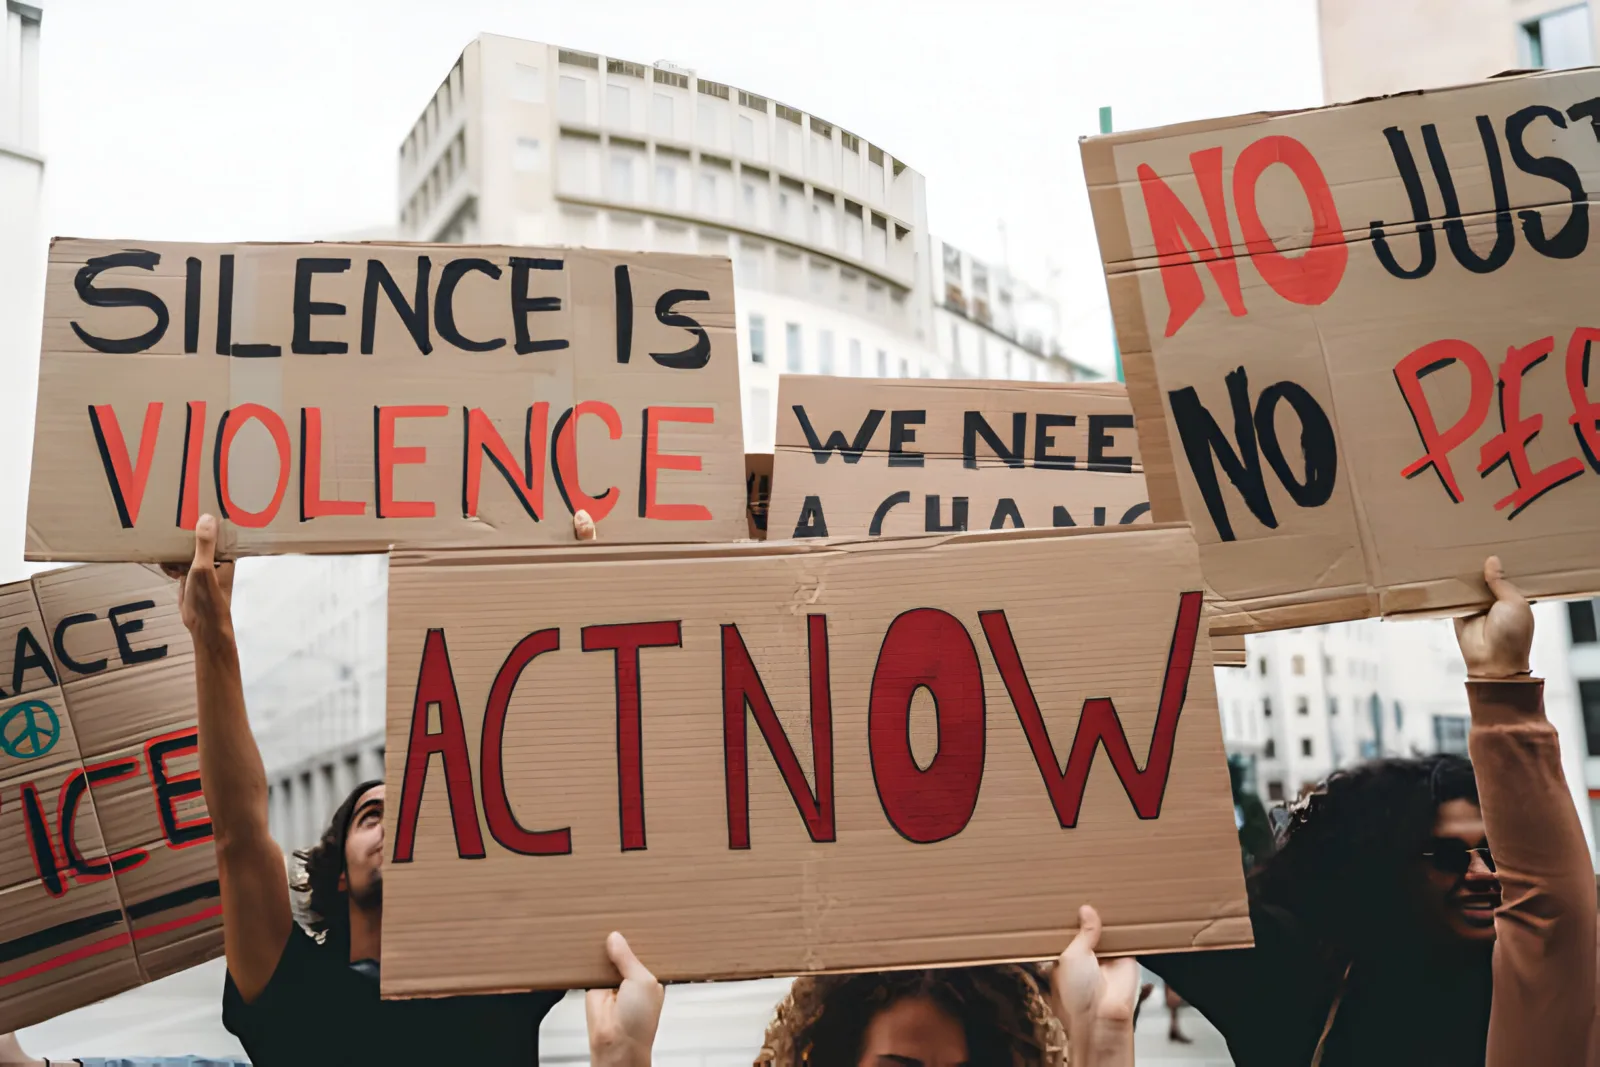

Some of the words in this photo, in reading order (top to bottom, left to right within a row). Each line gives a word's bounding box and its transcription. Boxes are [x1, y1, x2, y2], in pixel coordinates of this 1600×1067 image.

[1137, 135, 1348, 337] NO
[70, 248, 570, 358] SILENCE
[615, 264, 712, 370] IS
[88, 401, 715, 529] VIOLENCE
[791, 404, 927, 468] WE
[962, 410, 1134, 474] NEE
[1168, 365, 1338, 543] NO
[792, 495, 829, 538] A
[868, 490, 1151, 537] CHA
[0, 600, 168, 698] ACE
[392, 620, 683, 864] ACT
[719, 590, 1204, 850] NOW
[0, 725, 215, 899] ICE
